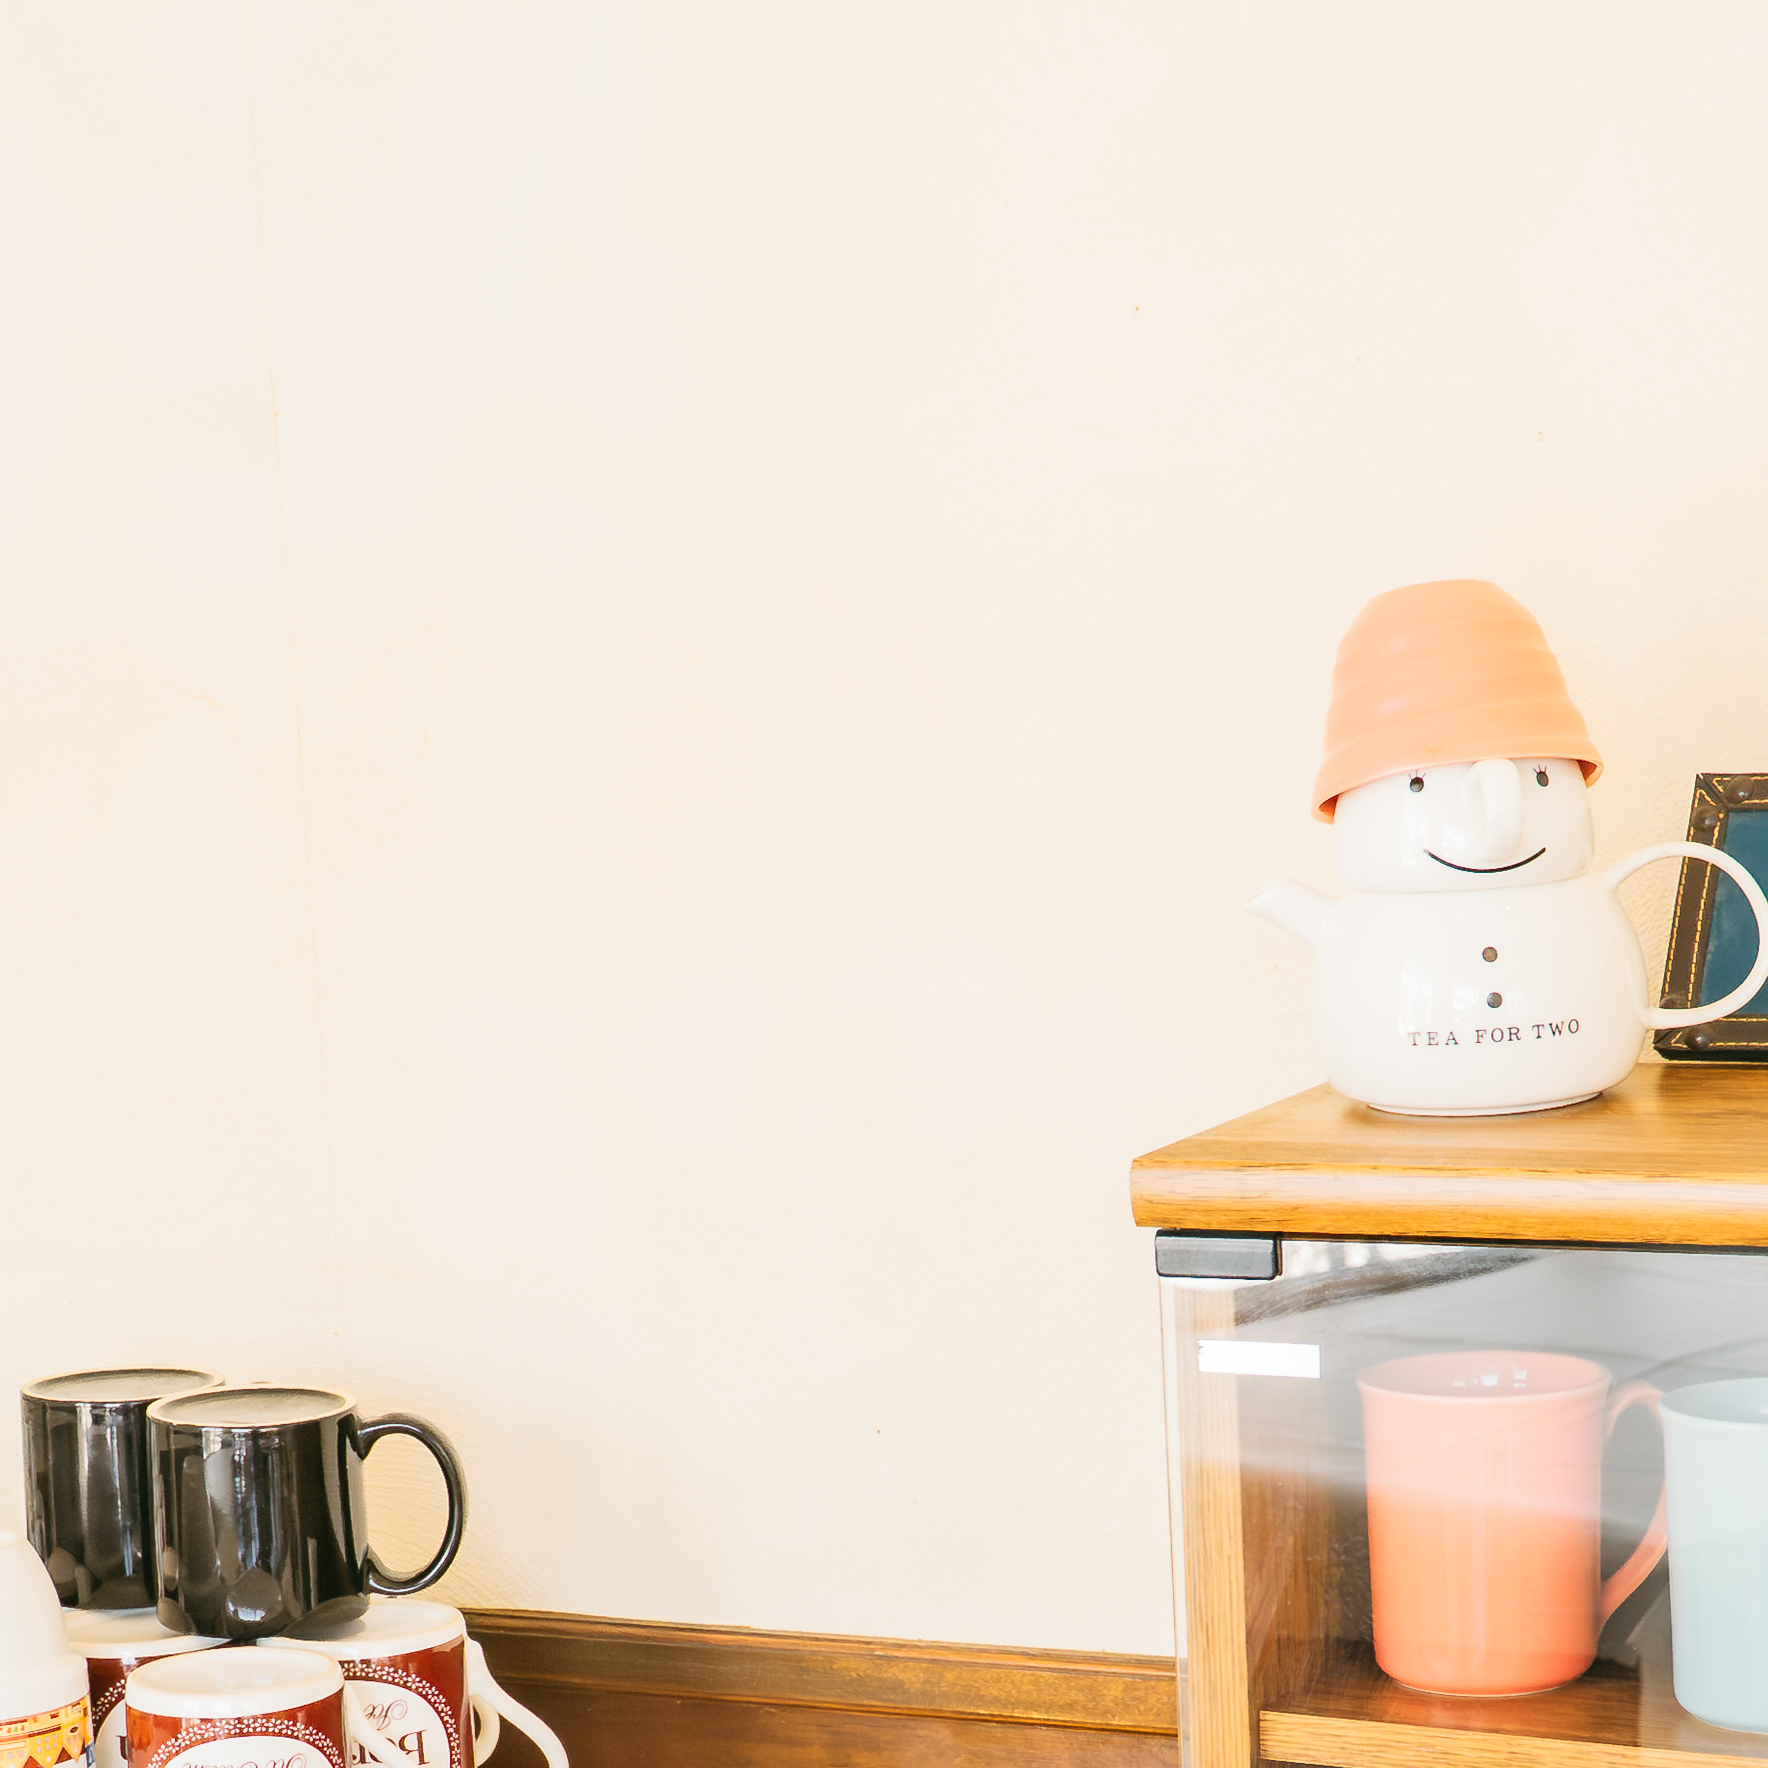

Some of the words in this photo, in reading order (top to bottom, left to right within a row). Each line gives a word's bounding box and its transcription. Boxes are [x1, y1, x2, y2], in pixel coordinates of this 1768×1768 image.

[1407, 1031, 1459, 1046] TEA
[1475, 1026, 1522, 1044] FOR
[1532, 1018, 1580, 1040] TWO
